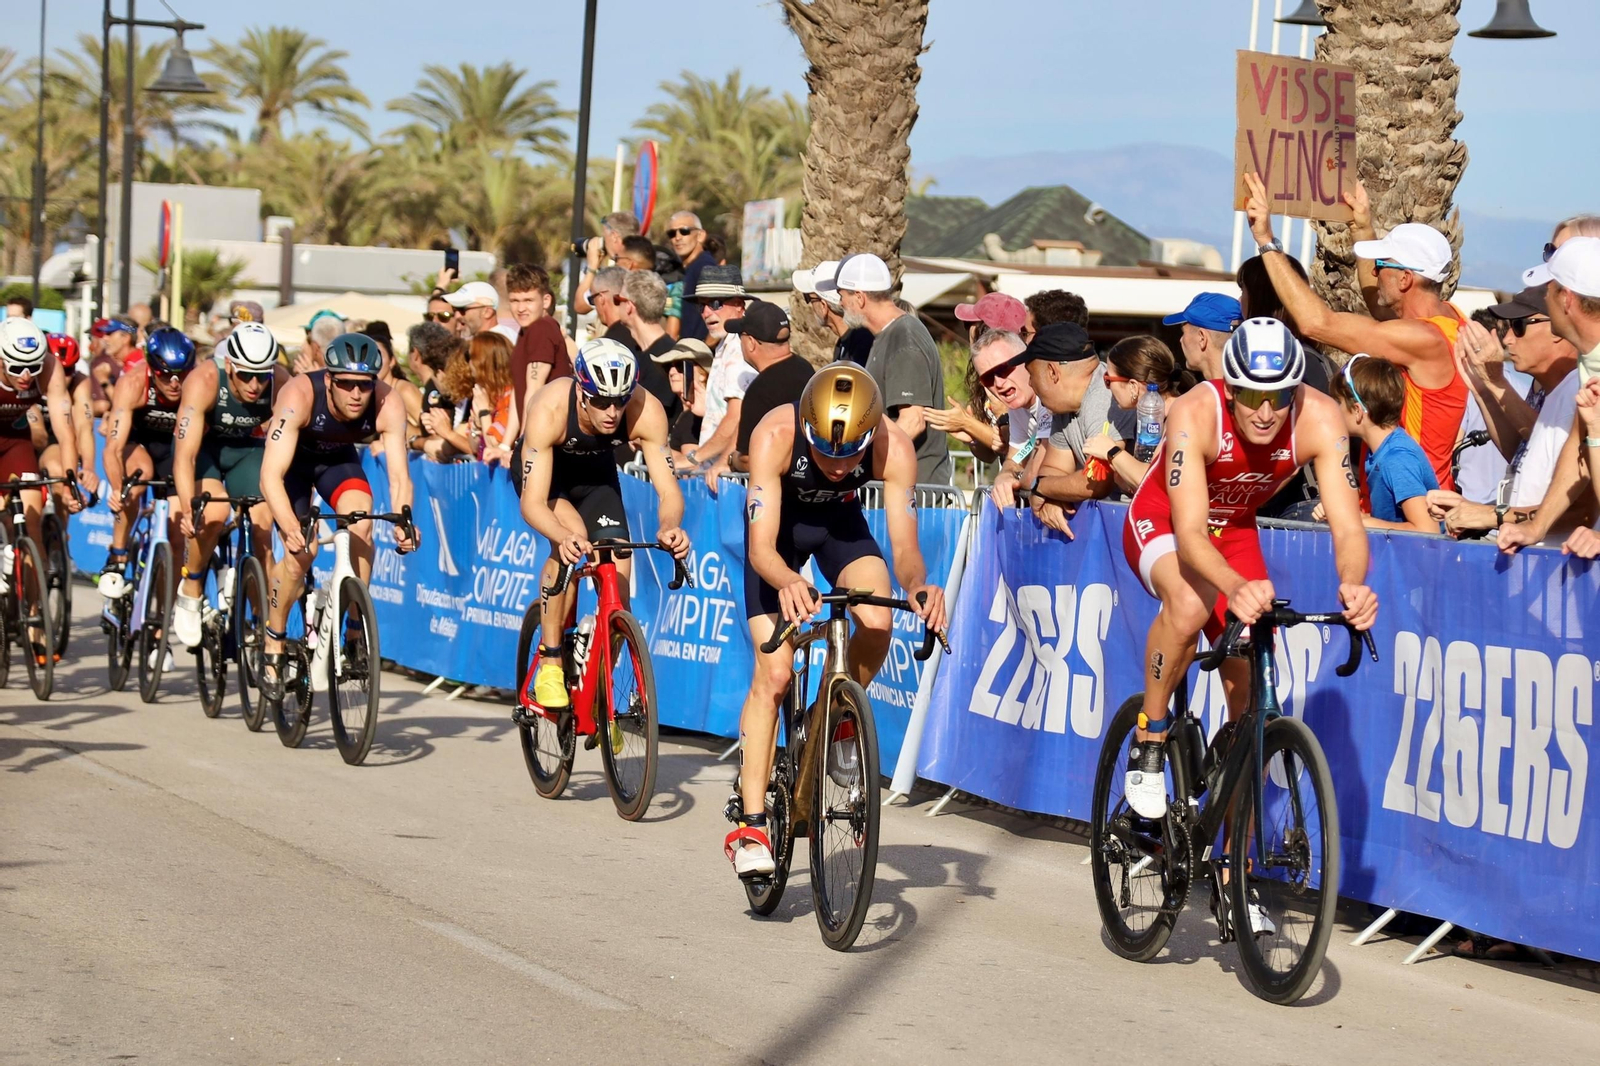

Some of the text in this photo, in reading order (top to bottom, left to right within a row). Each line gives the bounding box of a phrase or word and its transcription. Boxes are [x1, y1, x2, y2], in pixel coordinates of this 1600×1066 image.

[1246, 128, 1356, 206] VINCE
[270, 418, 287, 441] 16
[665, 456, 676, 477] 5
[1017, 441, 1033, 459] 3857
[1169, 449, 1185, 488] 48
[1218, 472, 1274, 483] JOL
[1341, 452, 1361, 490] 48
[1210, 492, 1255, 505] AUT
[477, 518, 537, 568] MÁLAGA
[1136, 518, 1156, 540] JOL
[372, 547, 406, 587] MPITE
[681, 548, 732, 593] AGA
[270, 588, 279, 609] 16
[472, 565, 535, 611] OMPITE
[660, 594, 736, 643] MPITE
[681, 642, 697, 661] EN
[1382, 630, 1593, 849] 226ERS
